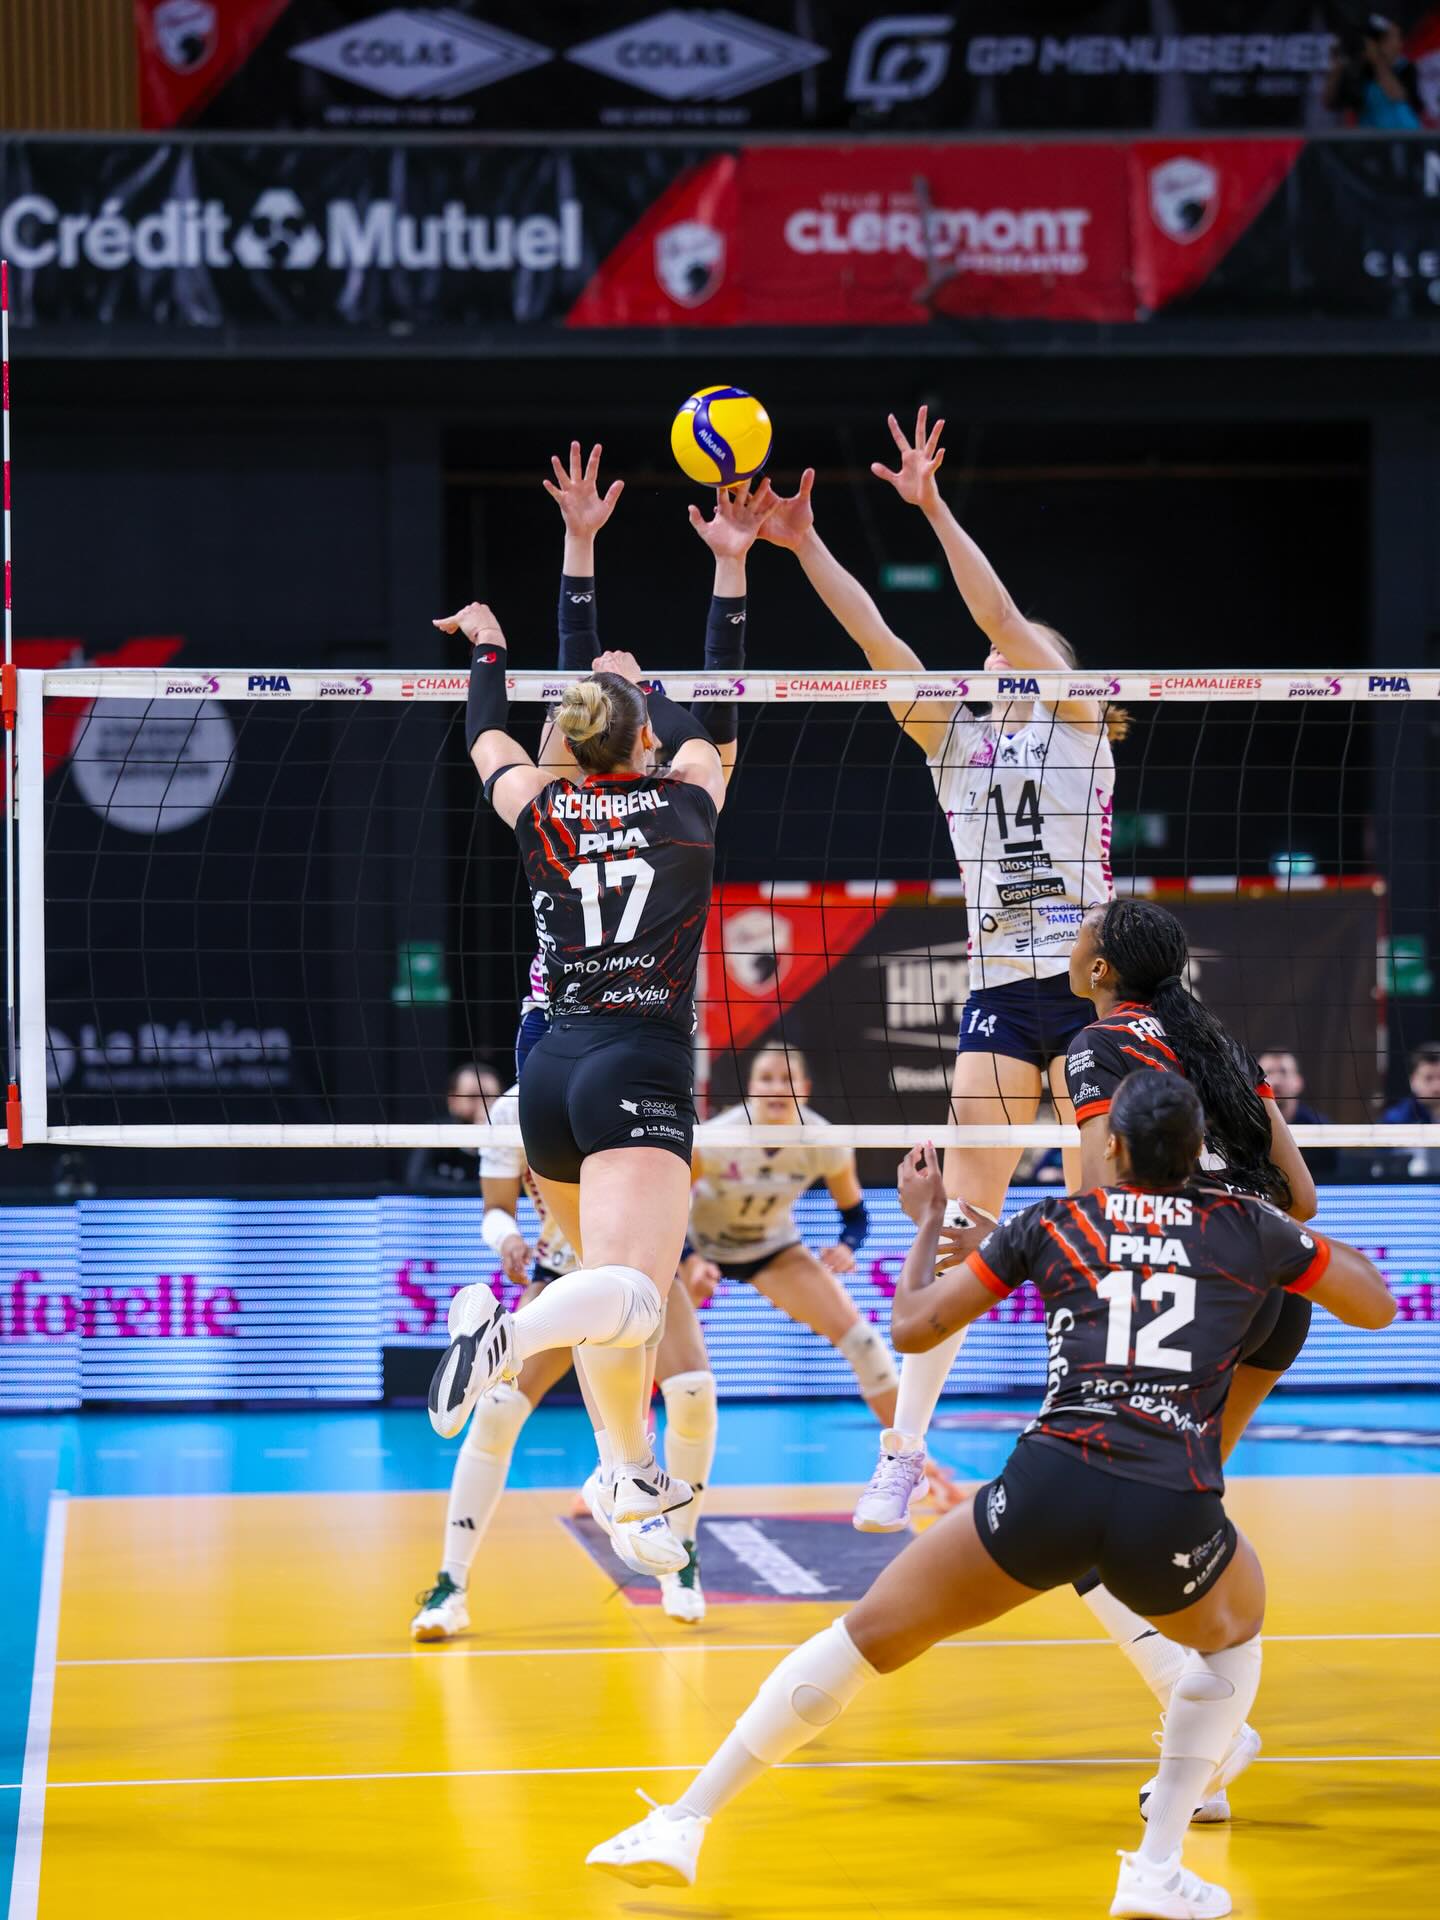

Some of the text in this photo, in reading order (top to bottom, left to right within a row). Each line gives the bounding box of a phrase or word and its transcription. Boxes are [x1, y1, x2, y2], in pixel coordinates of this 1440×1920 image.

[339, 40, 459, 68] COLAS
[614, 41, 734, 69] COLAS
[966, 36, 1035, 75] GP
[0, 196, 582, 268] Crédit Mutuel
[247, 675, 291, 692] PHA
[997, 678, 1040, 695] PHA
[1368, 675, 1411, 692] PHA
[551, 788, 669, 821] SCHABERL
[988, 779, 1045, 840] 14
[578, 827, 650, 855] PHA
[568, 856, 656, 948] 17
[563, 953, 656, 976] PRO IMMO
[967, 1008, 997, 1037] 14
[660, 1125, 685, 1138] Région
[1105, 1193, 1193, 1226] RICKS
[1109, 1234, 1191, 1268] PHA
[0, 1269, 240, 1337] forelle
[1096, 1269, 1198, 1373] 12
